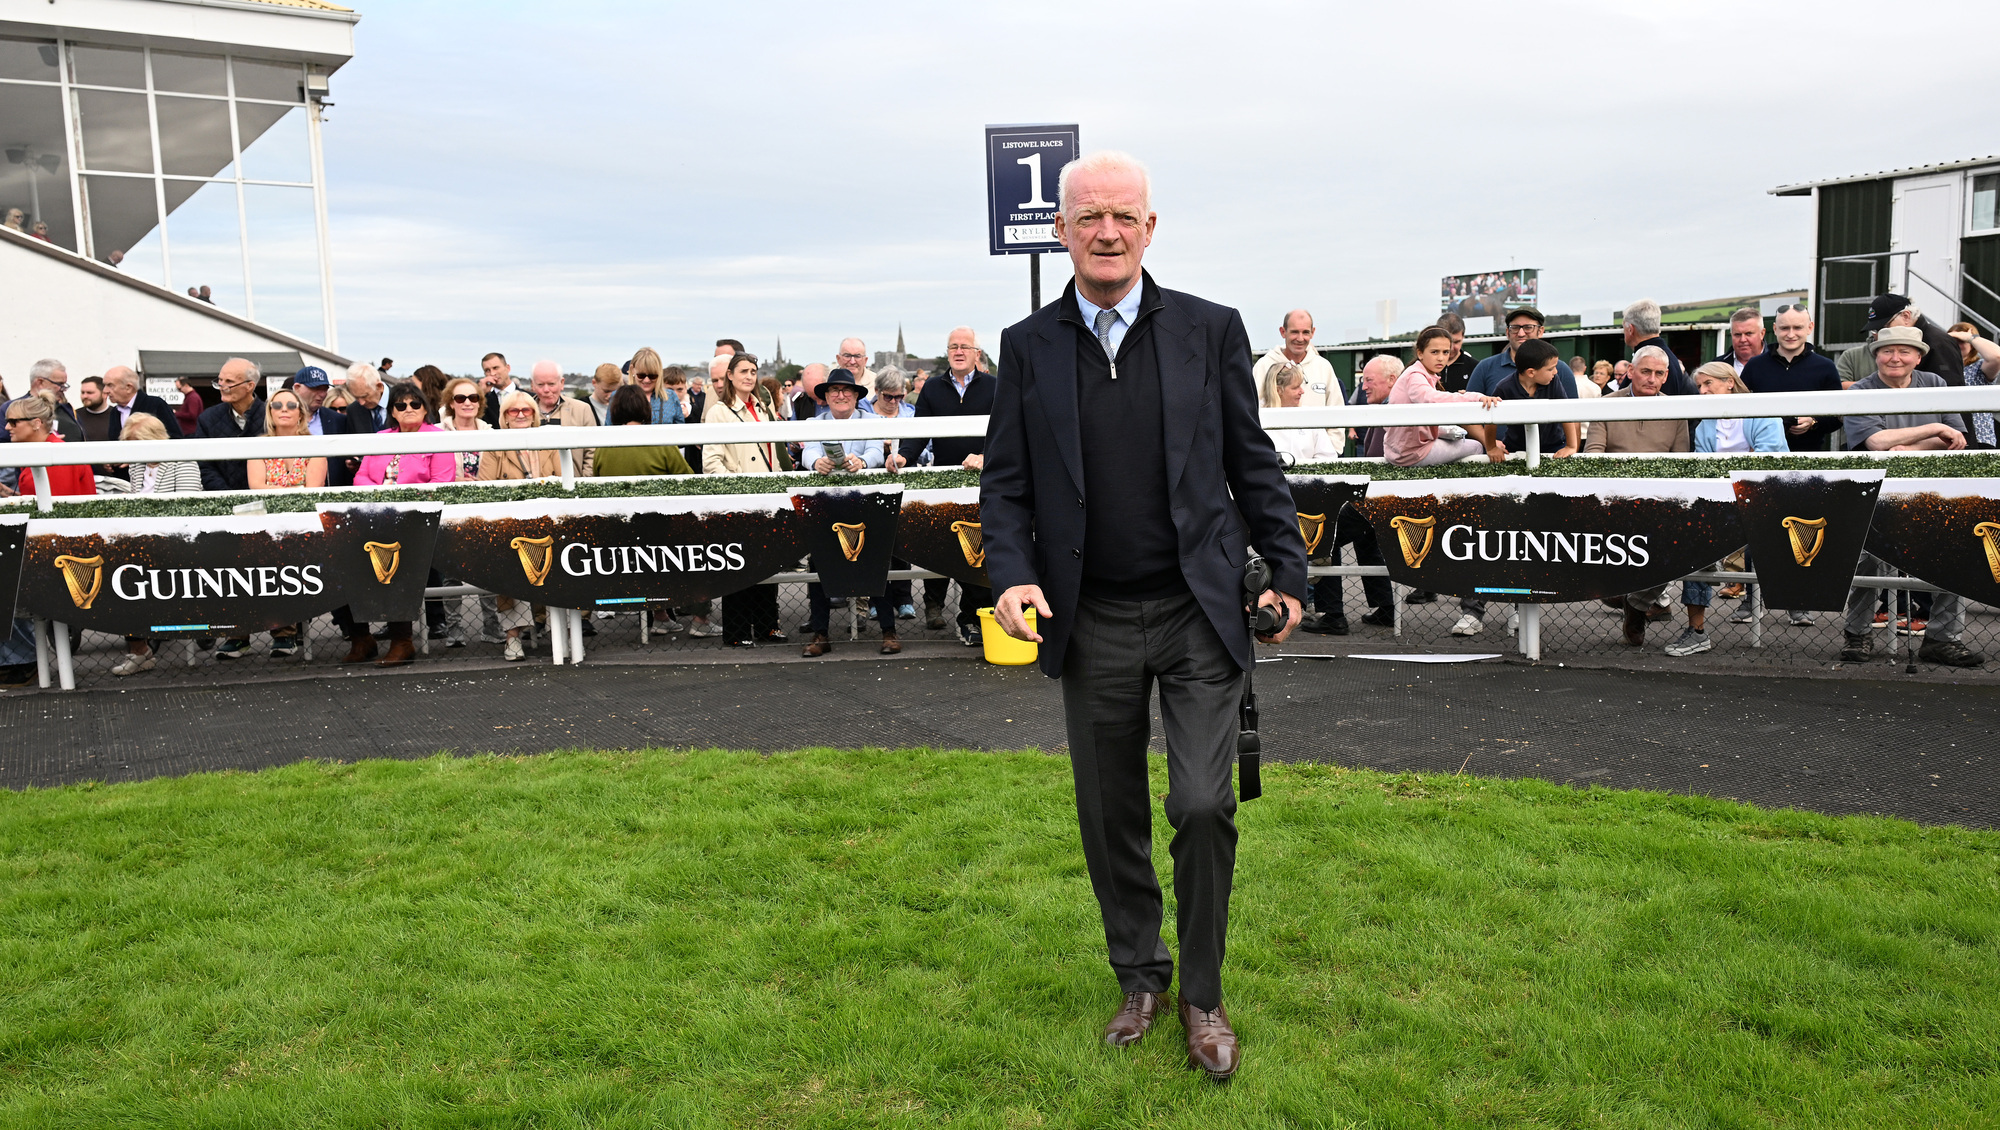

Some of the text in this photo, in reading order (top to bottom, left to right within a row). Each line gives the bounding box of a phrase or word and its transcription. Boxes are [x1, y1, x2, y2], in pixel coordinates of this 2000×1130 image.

[1002, 141, 1039, 149] LISTOWEL
[1017, 152, 1056, 209] 1
[1010, 212, 1056, 221] FIRST PLAC
[560, 543, 745, 576] GUINNESS
[1441, 524, 1650, 567] GUINNESS
[111, 564, 324, 600] GUINNESS
